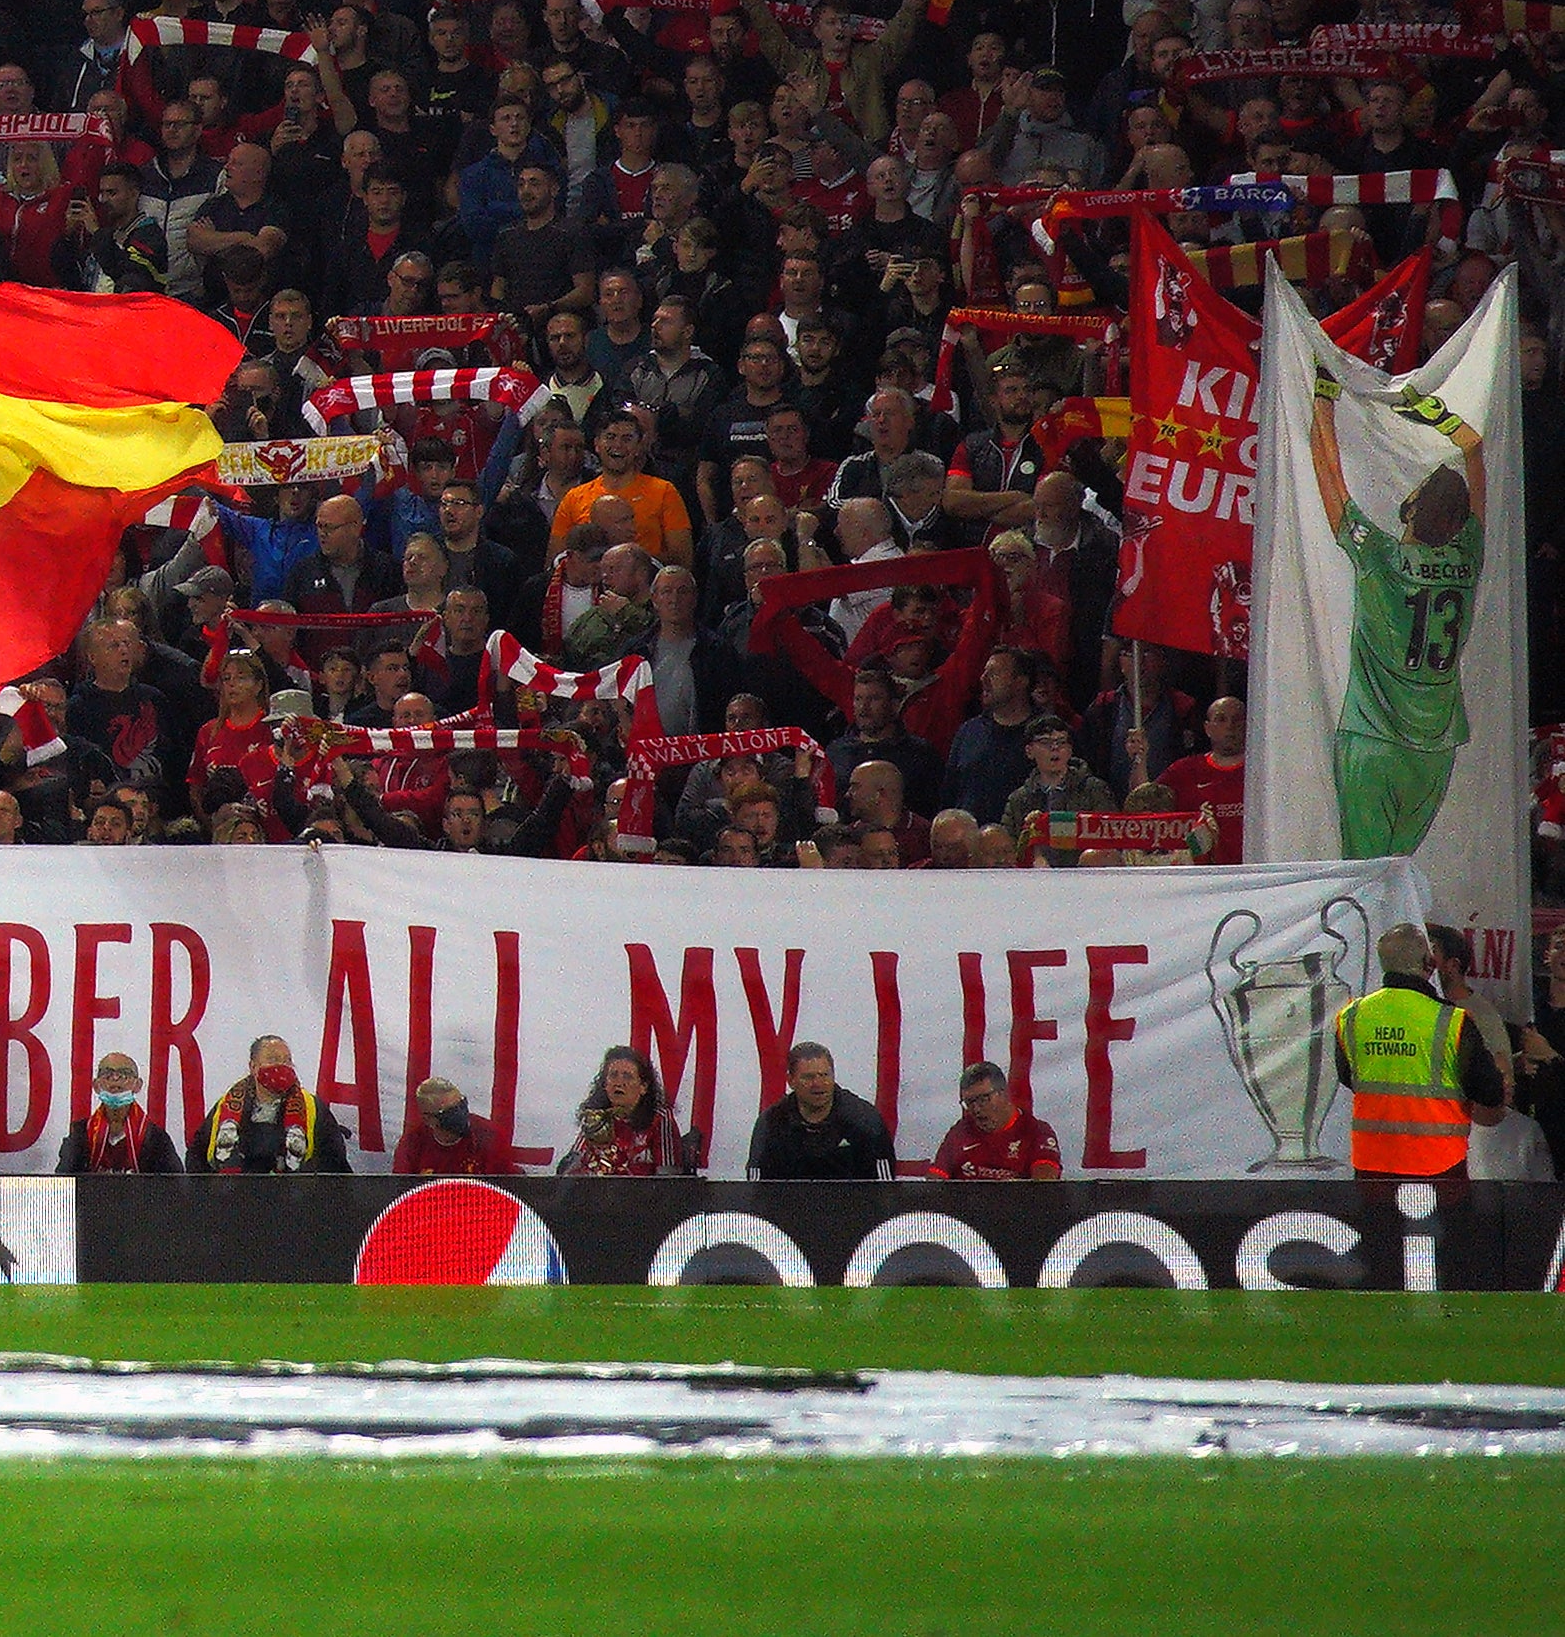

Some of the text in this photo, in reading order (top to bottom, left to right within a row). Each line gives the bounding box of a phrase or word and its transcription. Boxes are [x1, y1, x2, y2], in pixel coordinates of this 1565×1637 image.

[1200, 47, 1363, 73] LIVERPOOL
[1084, 191, 1138, 208] LIVERPOOL
[1142, 190, 1158, 204] FC
[375, 318, 467, 336] LIVERPOOL
[1177, 360, 1259, 424] KI
[1125, 450, 1259, 524] EUR
[1404, 588, 1465, 673] 13
[645, 730, 792, 765] WALK ALONE
[317, 919, 554, 1166] ALL
[624, 942, 805, 1169] MY
[868, 944, 1149, 1176] LIFE
[1374, 1026, 1406, 1041] HEAD
[1364, 1041, 1418, 1057] STEWARD
